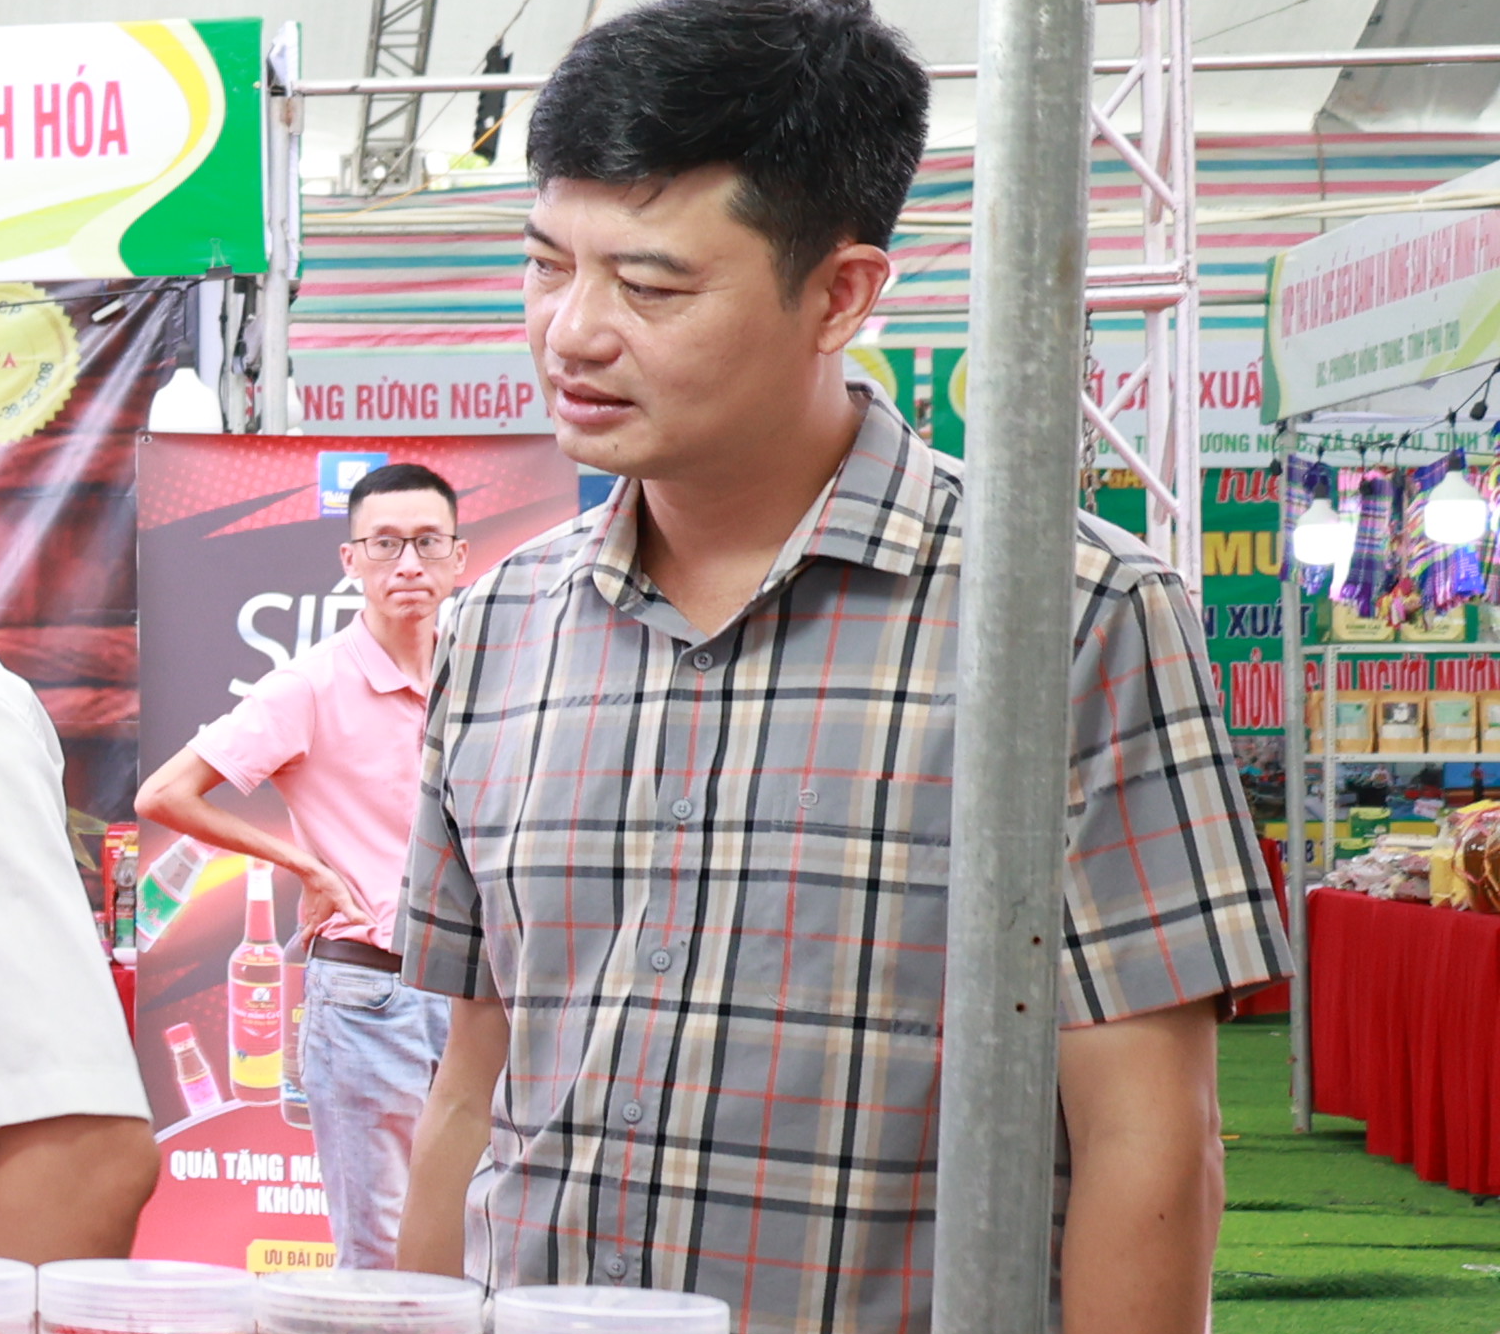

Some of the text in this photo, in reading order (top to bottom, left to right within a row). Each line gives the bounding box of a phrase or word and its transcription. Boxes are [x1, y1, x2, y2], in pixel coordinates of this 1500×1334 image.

[34, 64, 129, 158] HÓA
[450, 374, 534, 428] NGẬP
[170, 1147, 285, 1185] QUÀ TẶNG
